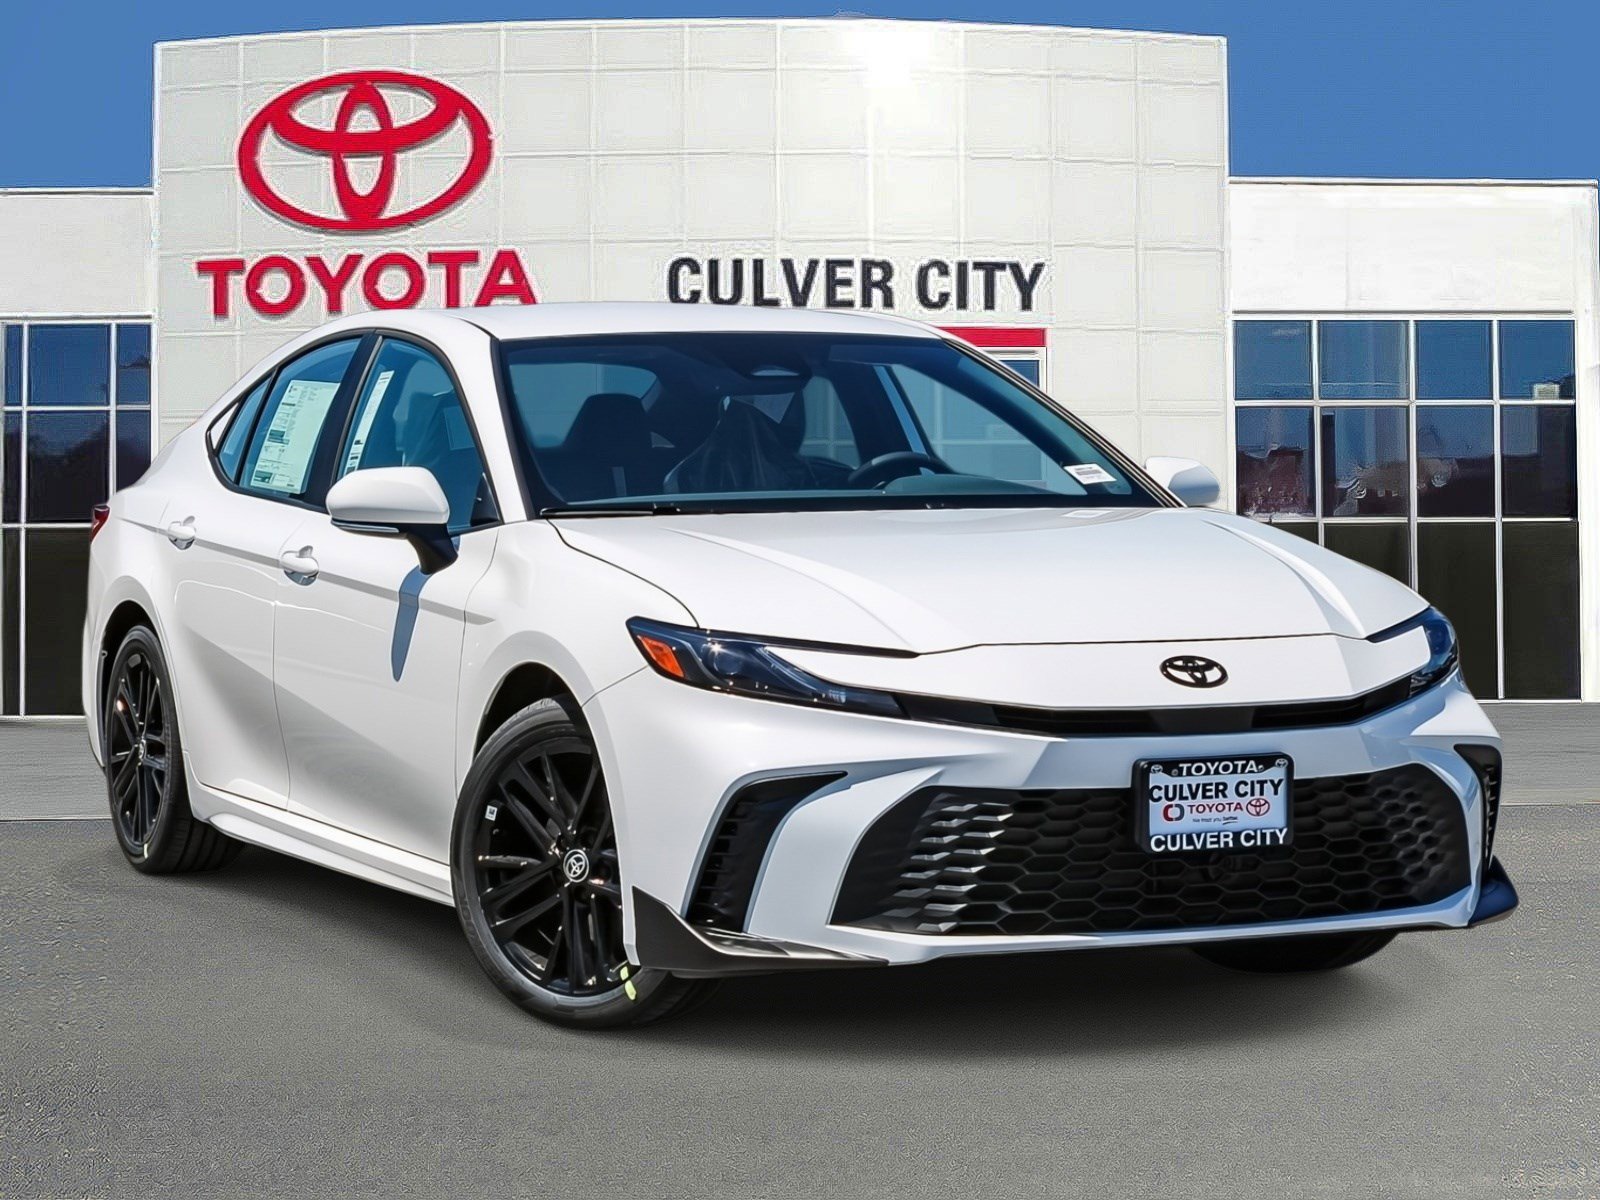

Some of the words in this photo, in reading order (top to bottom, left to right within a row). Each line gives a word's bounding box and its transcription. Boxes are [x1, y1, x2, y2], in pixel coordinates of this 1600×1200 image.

[196, 250, 538, 317] TOYOTA
[668, 257, 896, 309] CULVER
[915, 259, 1046, 311] CITY
[1179, 760, 1258, 776] TOYOTA
[1150, 782, 1228, 802] CULVER
[1235, 778, 1284, 797] CITY
[1187, 802, 1244, 814] TOYOTA
[1150, 831, 1234, 852] CULVER
[1240, 827, 1288, 847] CITY
